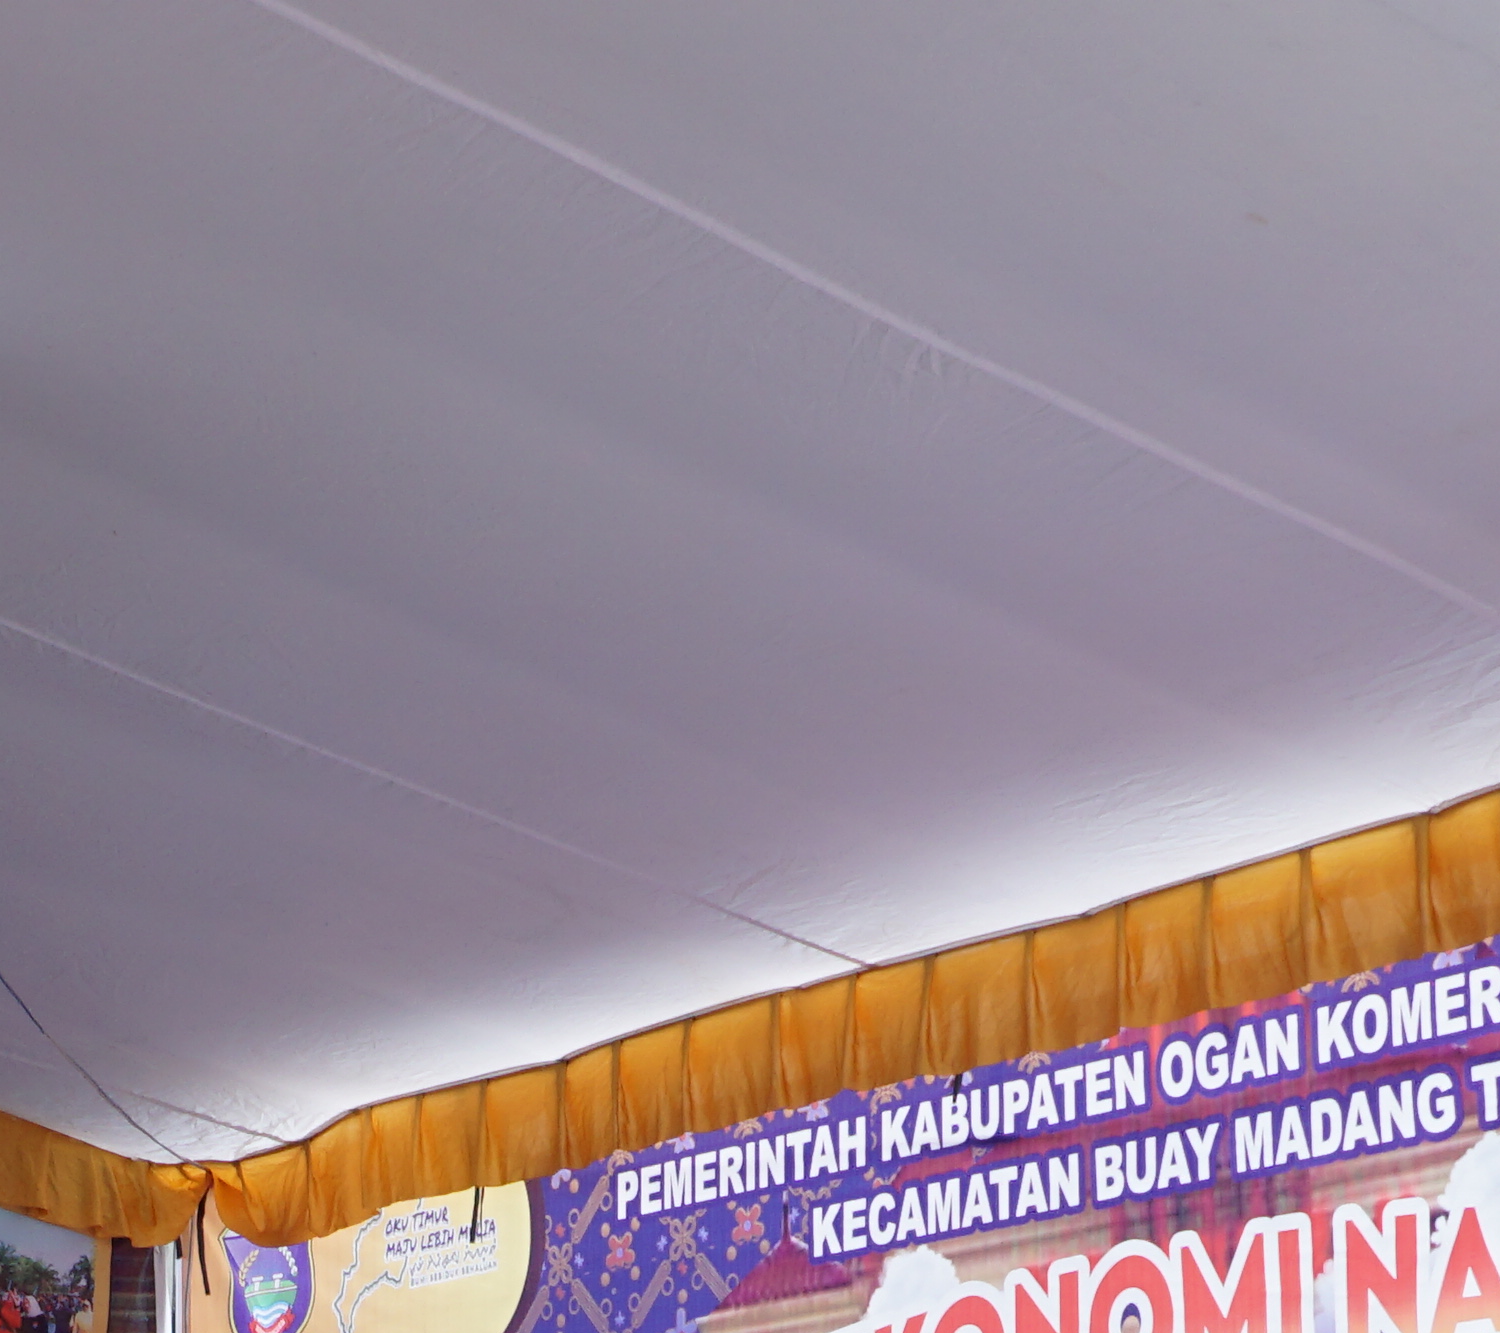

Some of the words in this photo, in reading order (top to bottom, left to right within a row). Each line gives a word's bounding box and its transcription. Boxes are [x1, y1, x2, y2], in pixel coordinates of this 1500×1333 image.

[616, 1117, 866, 1221] PEMERINTAH
[881, 1049, 1146, 1150] KABUPATEN
[1160, 1014, 1301, 1098] OGAN
[811, 1157, 1082, 1258] KECAMATAN
[1094, 1132, 1217, 1202] BUAY
[1234, 1077, 1456, 1175] MADANG
[385, 1215, 409, 1236] OKU
[412, 1206, 449, 1231] TIMUR
[459, 1218, 496, 1241] MLIA
